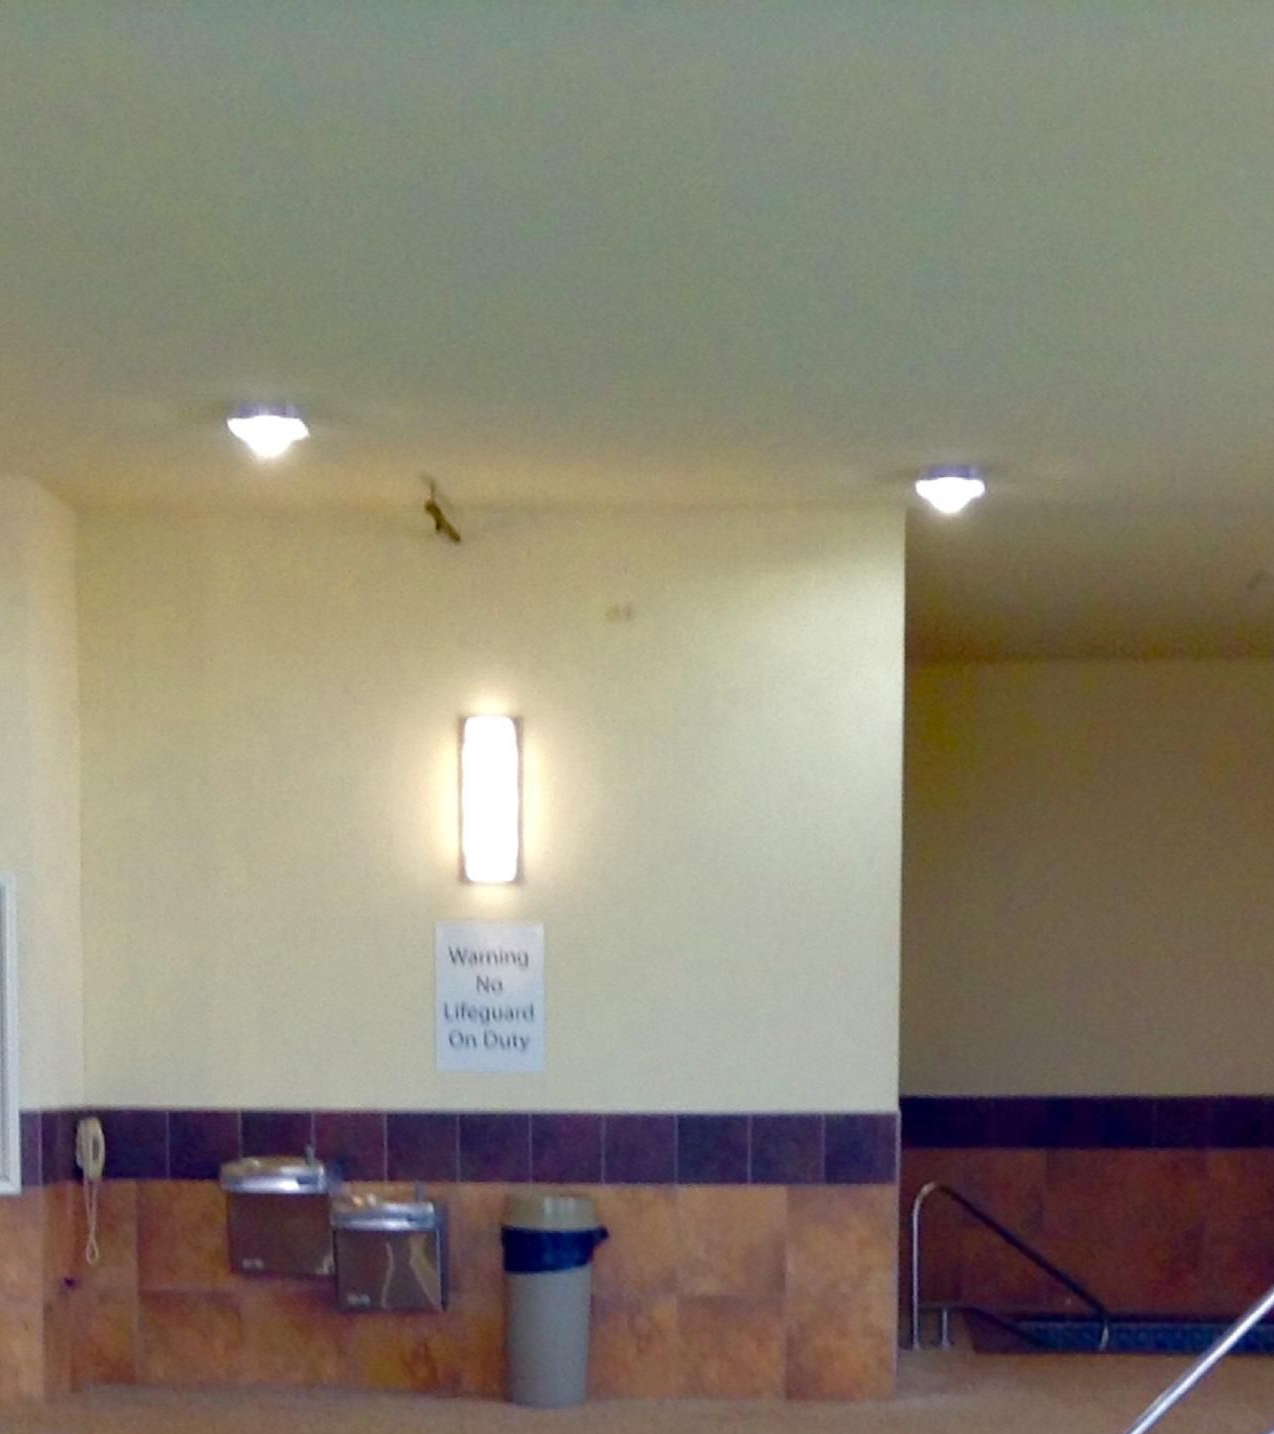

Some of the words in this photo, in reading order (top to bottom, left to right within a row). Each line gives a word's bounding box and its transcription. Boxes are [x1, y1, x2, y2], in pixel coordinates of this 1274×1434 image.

[447, 946, 529, 968] Warning
[475, 976, 503, 995] No
[443, 1002, 534, 1025] Lifeguard
[448, 1030, 477, 1049] On
[483, 1030, 530, 1051] Duty
